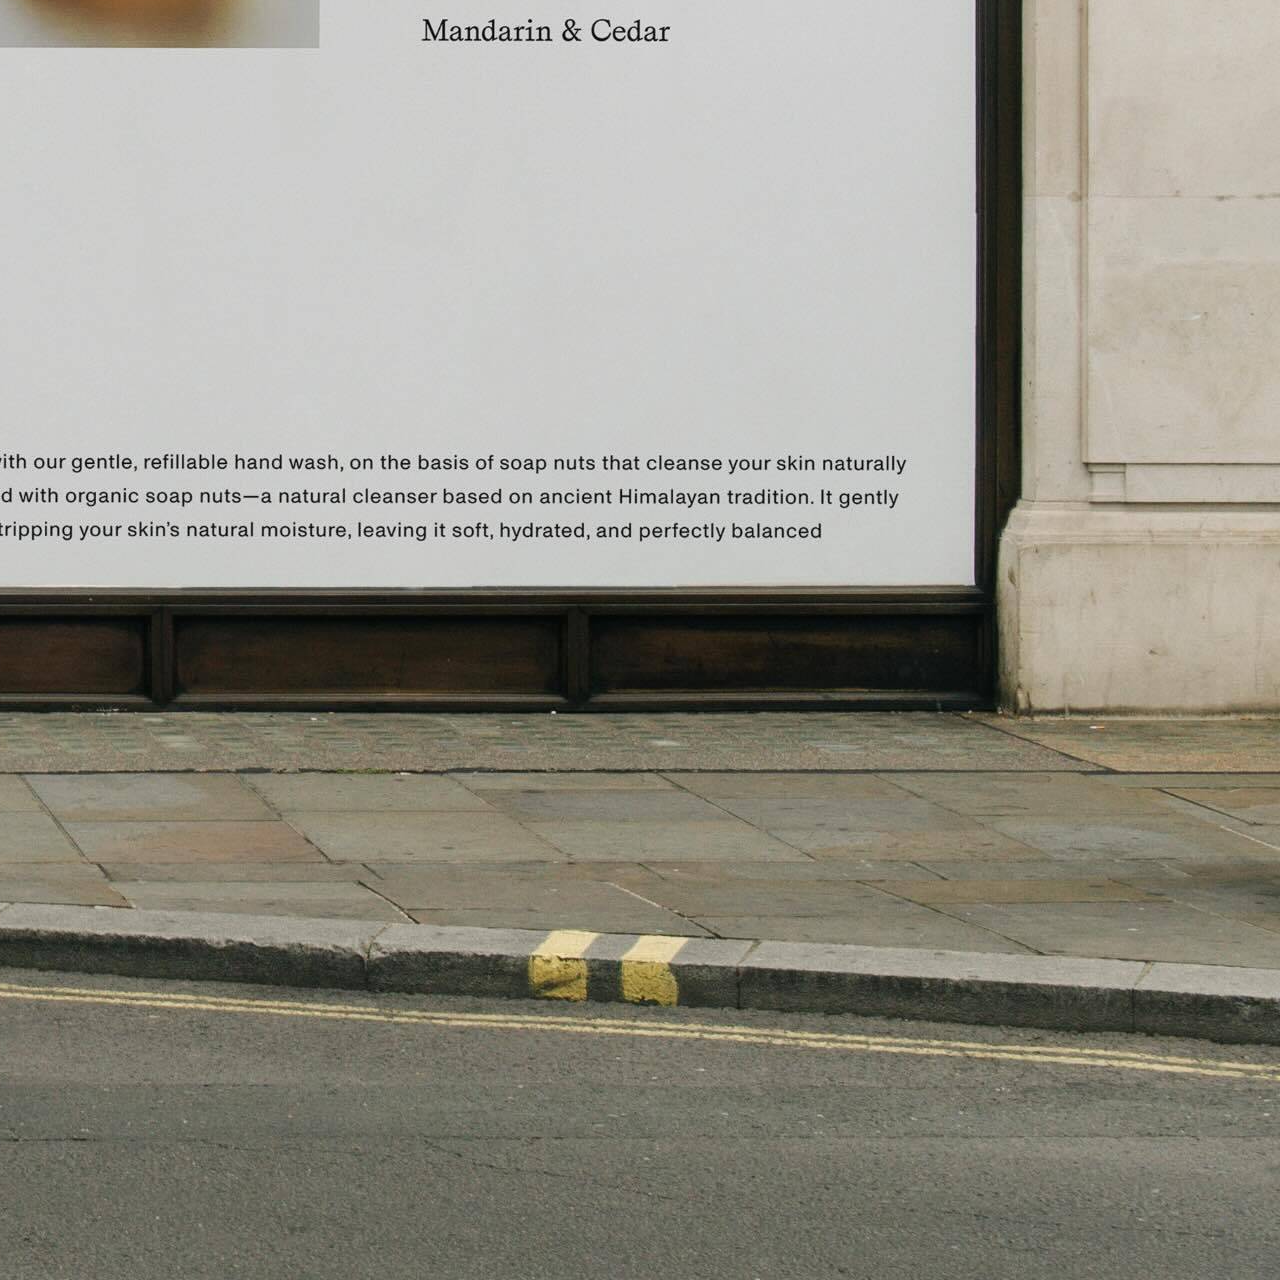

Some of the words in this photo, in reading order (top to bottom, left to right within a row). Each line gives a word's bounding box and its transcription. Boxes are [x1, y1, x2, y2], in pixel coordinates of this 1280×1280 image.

[421, 18, 553, 42] Mandarin
[561, 18, 582, 42] &
[590, 18, 671, 42] Cedar
[33, 457, 67, 470] our
[71, 453, 138, 474] gentle,
[143, 453, 228, 470] refillable
[234, 453, 283, 470] hand
[288, 453, 344, 473] wash,
[349, 457, 374, 471] on
[379, 454, 412, 471] the
[417, 454, 469, 471] basis
[475, 454, 495, 471] of
[499, 458, 547, 475] soap
[553, 455, 596, 471] nuts
[601, 454, 641, 471] that
[646, 454, 723, 471] cleanse
[728, 458, 772, 475] your
[776, 455, 816, 471] skin
[822, 455, 907, 476] naturally
[18, 487, 59, 504] with
[65, 487, 139, 508] organic
[145, 491, 193, 508] soap
[278, 487, 346, 504] natural
[352, 487, 438, 505] cleanser
[442, 487, 503, 505] based
[508, 491, 533, 505] on
[539, 488, 613, 505] ancient
[619, 488, 721, 509] Himalayan
[726, 488, 815, 505] tradition.
[820, 488, 833, 505] It
[838, 489, 900, 510] gently
[79, 524, 123, 542] your
[186, 521, 254, 538] natural
[261, 521, 352, 540] moisture,
[357, 521, 427, 542] leaving
[434, 521, 446, 538] it
[451, 521, 494, 541] soft,
[499, 521, 591, 542] hydrated,
[595, 522, 632, 539] and
[639, 522, 726, 543] perfectly
[731, 522, 822, 539] balanced
